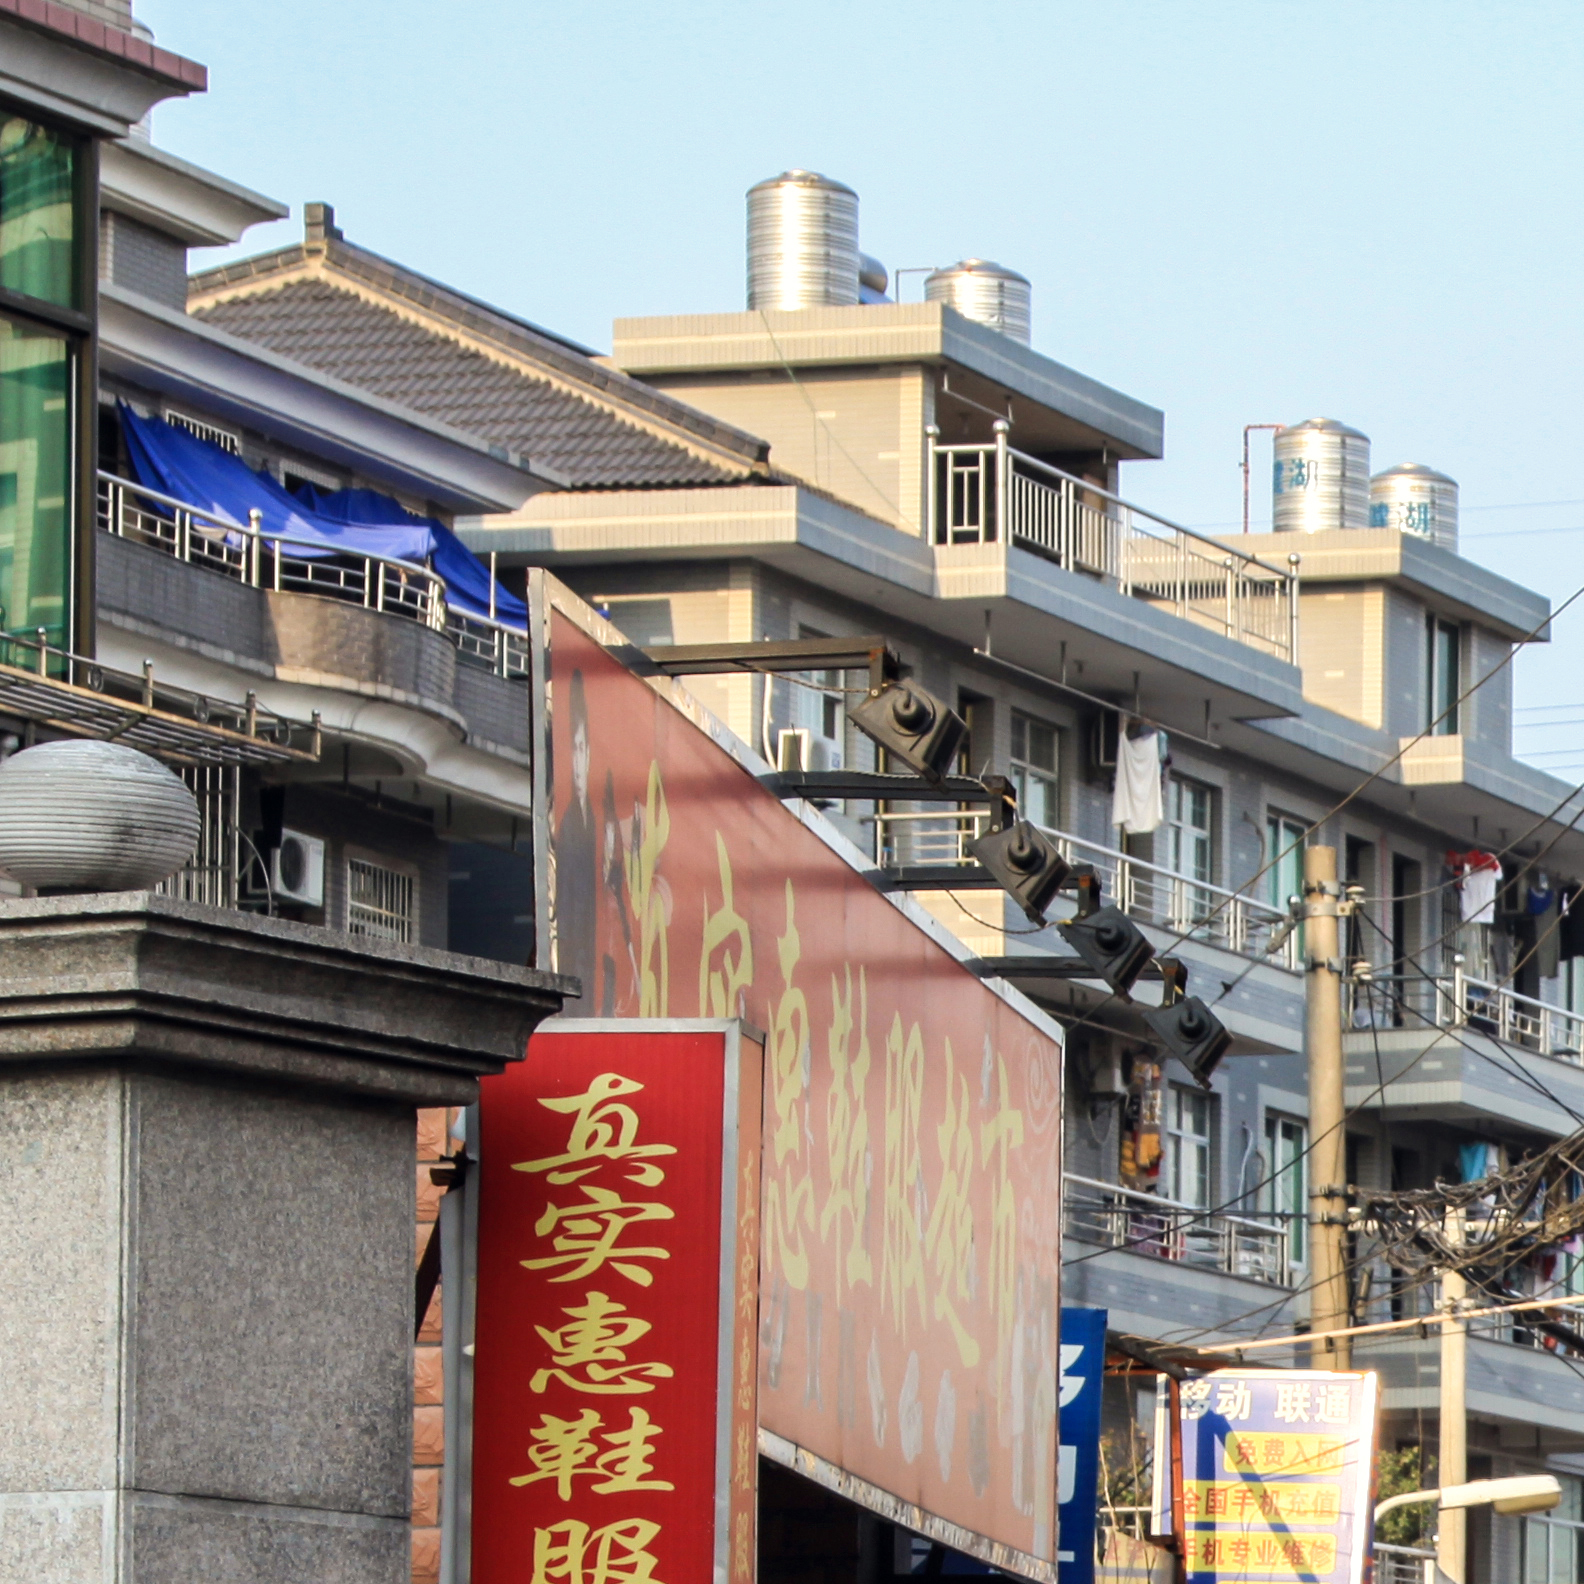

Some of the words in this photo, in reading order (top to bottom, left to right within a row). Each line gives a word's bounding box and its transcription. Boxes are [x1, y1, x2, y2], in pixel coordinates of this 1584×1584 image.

[1180, 1380, 1252, 1420] 移动
[1274, 1383, 1351, 1424] 联通
[1235, 1437, 1339, 1467] 免费入网
[1183, 1487, 1337, 1517] 全国手机充值
[1185, 1537, 1333, 1568] 手机专业维修
